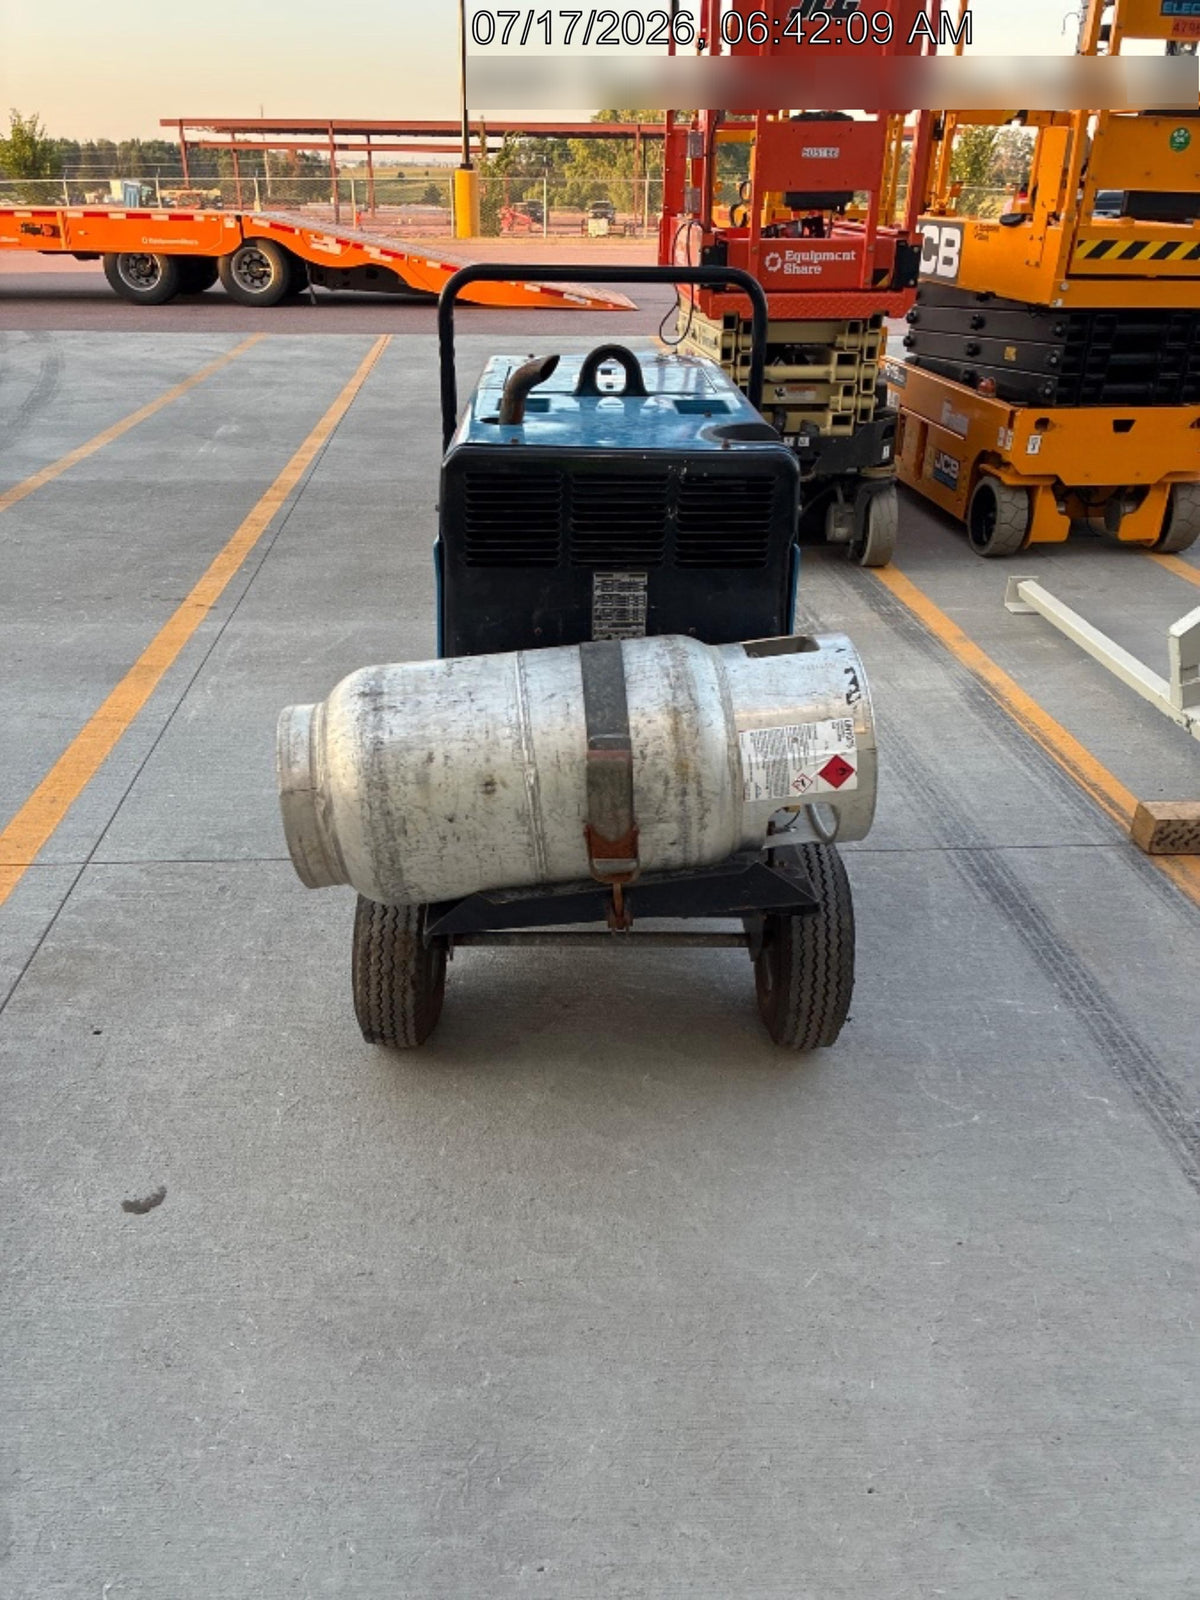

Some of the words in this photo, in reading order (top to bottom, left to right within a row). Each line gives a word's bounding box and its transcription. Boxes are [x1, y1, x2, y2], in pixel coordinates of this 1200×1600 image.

[785, 250, 856, 263] Equipment
[915, 224, 961, 278] CB
[783, 263, 822, 274] Share
[934, 451, 960, 479] JCB
